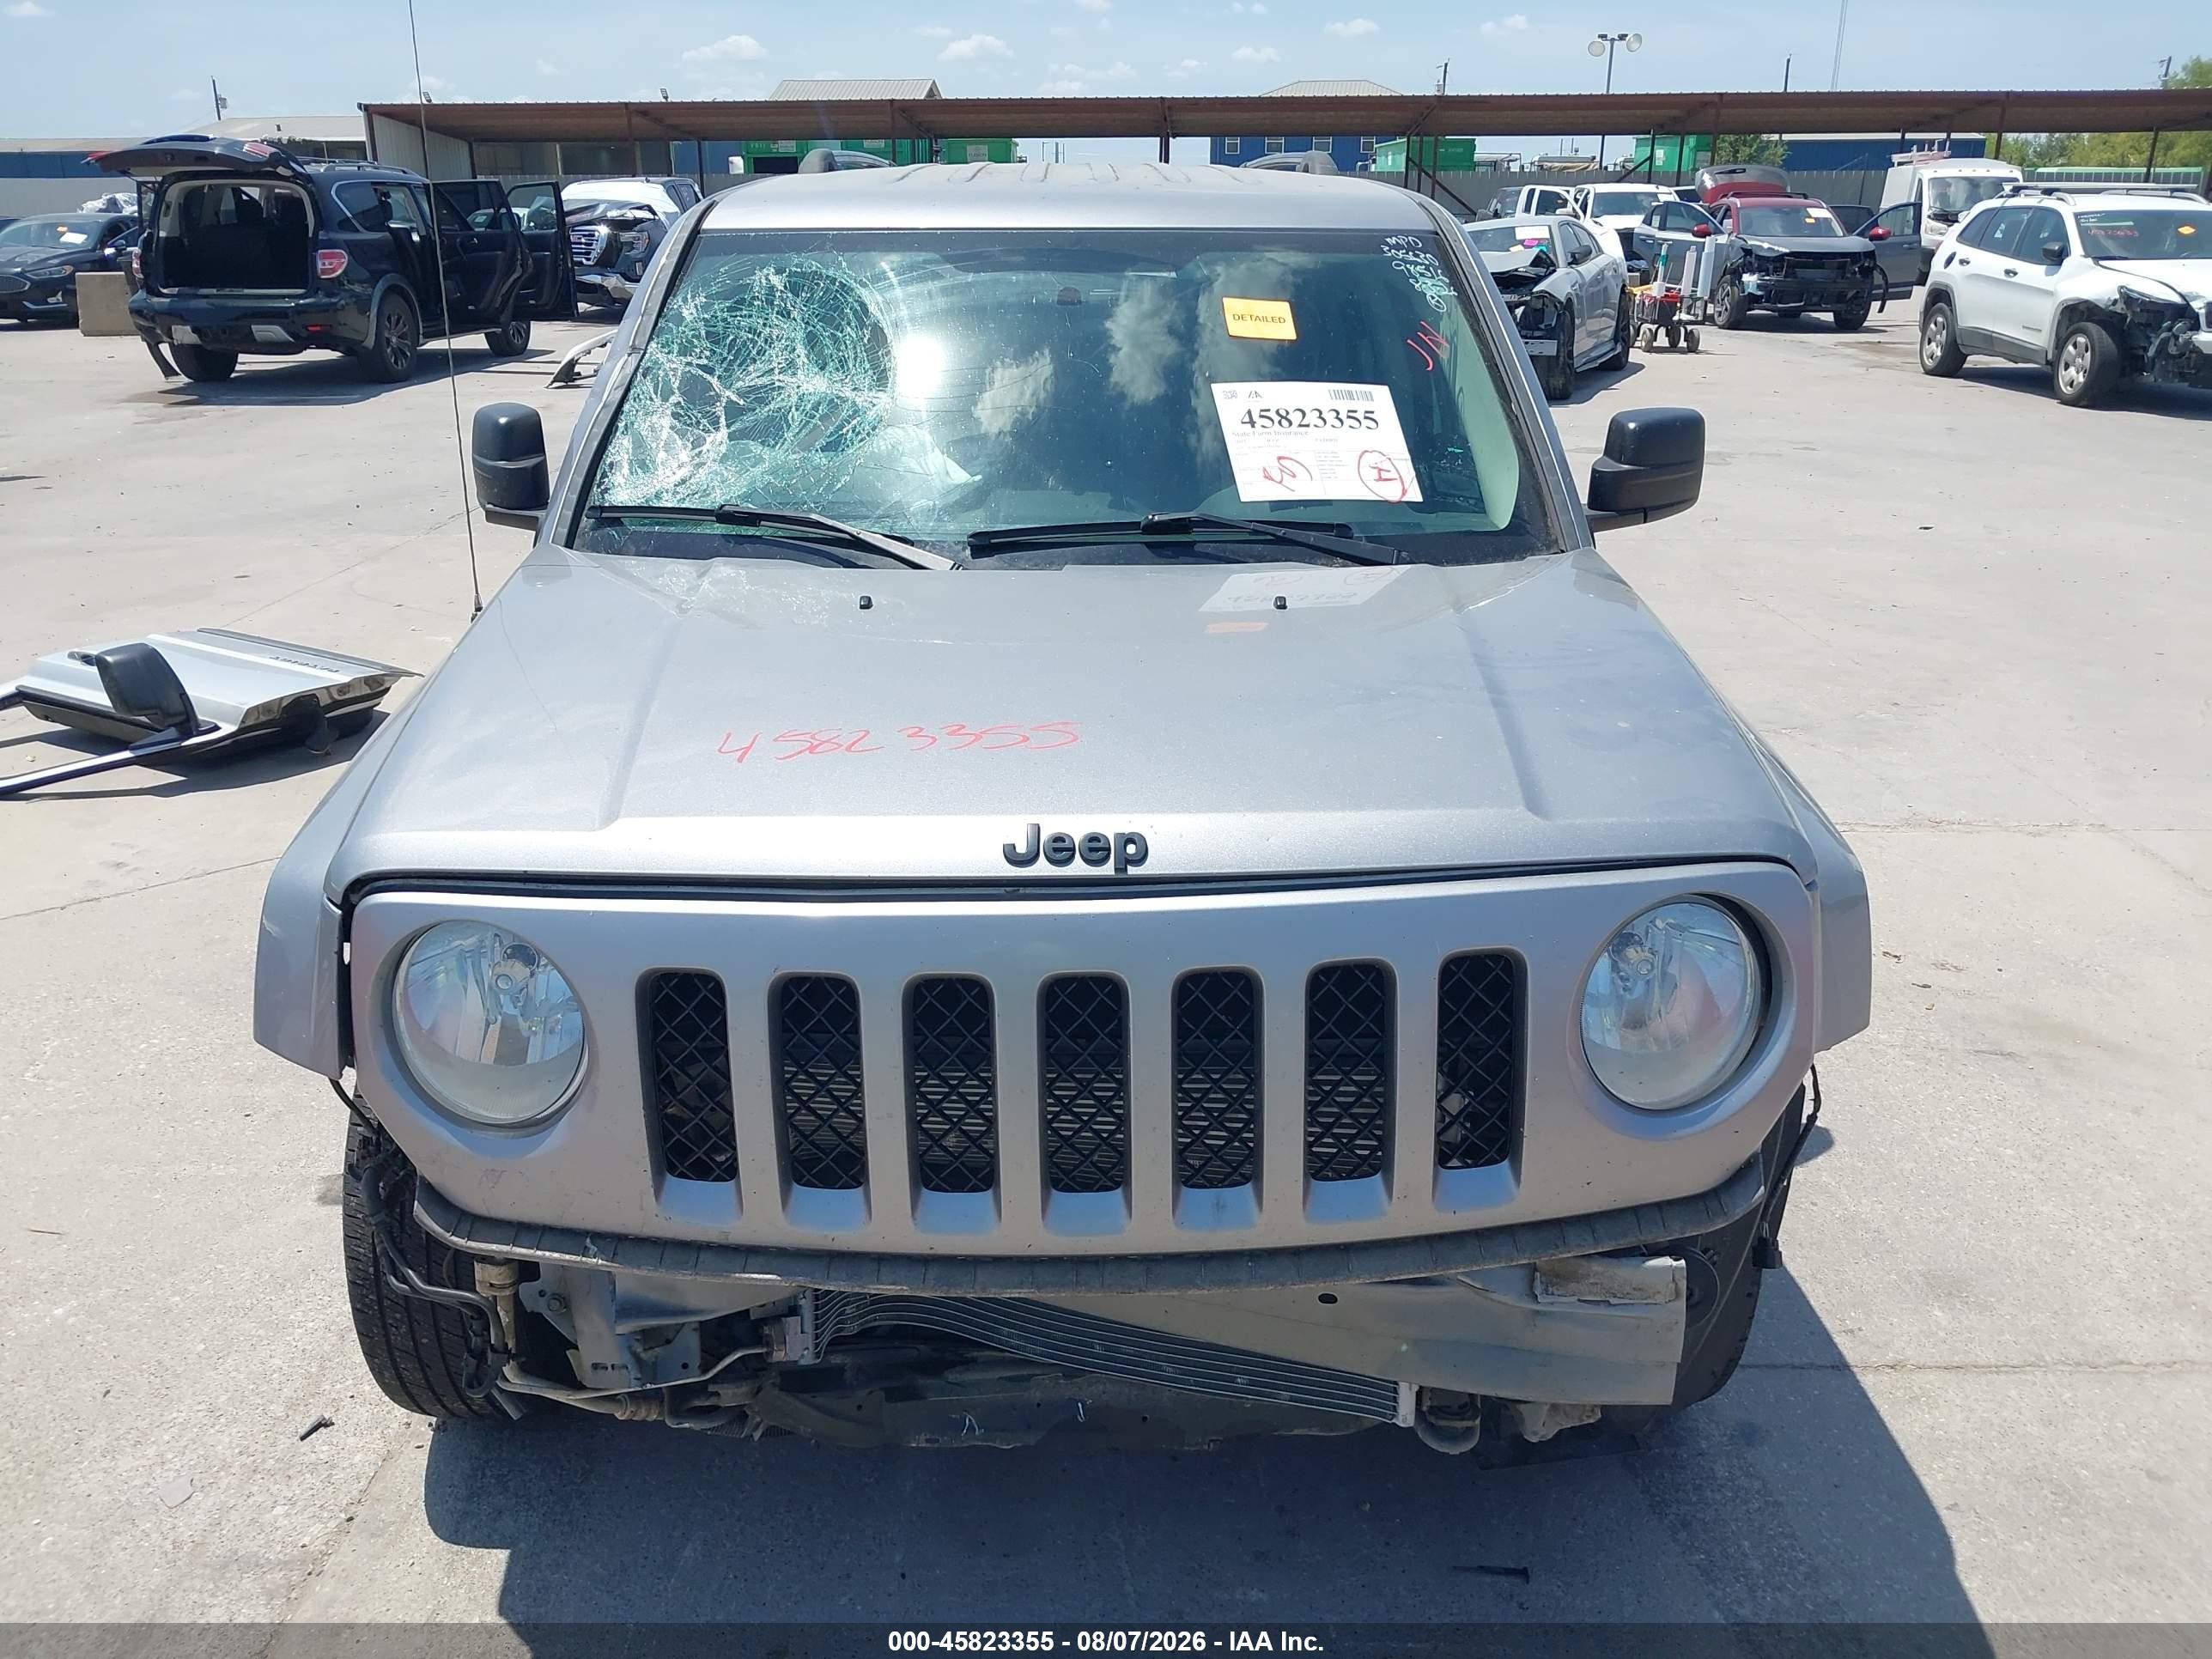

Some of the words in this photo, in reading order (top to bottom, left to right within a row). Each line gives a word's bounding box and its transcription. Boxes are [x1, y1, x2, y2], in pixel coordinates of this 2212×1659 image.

[1232, 313, 1286, 324] DETAILED
[1240, 407, 1379, 430] 45823355
[1003, 823, 1149, 876] Jeep
